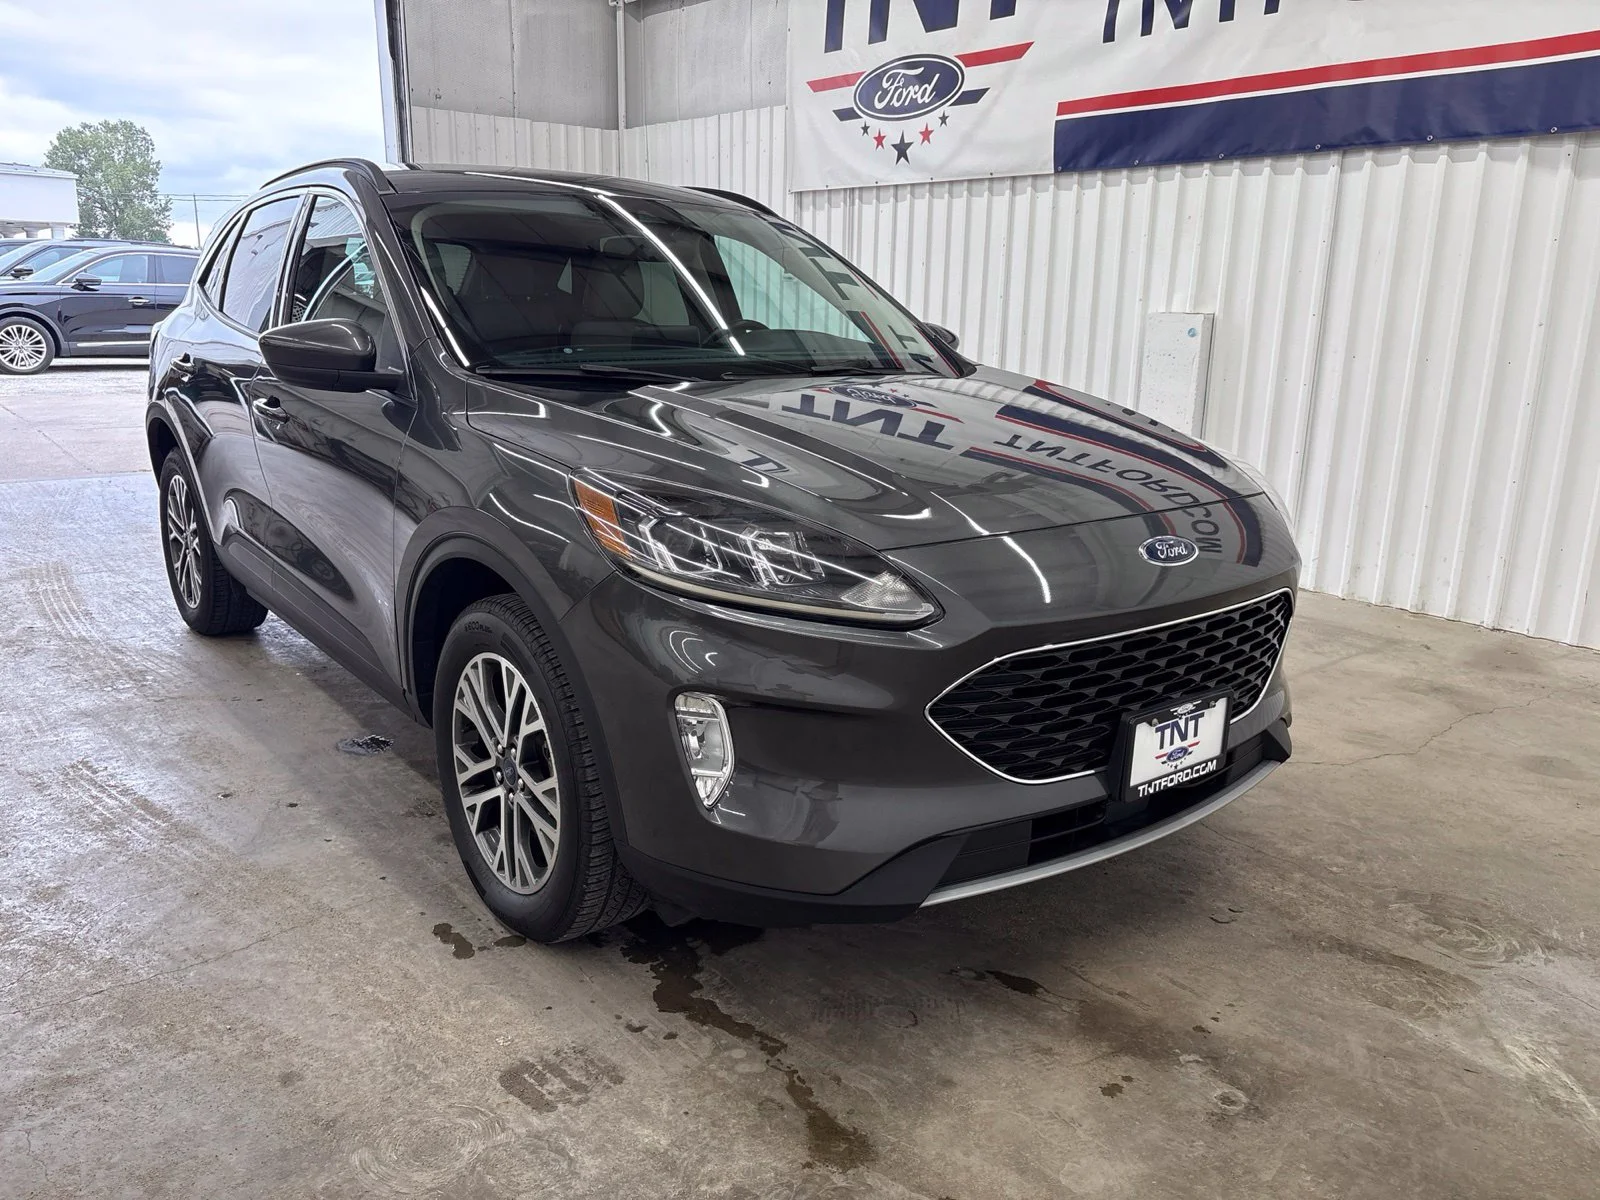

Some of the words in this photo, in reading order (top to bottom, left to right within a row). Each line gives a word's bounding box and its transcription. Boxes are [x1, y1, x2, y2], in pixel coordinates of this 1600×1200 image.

[874, 66, 941, 110] Ford
[1156, 540, 1188, 559] Ford
[1155, 712, 1204, 750] TNT
[1138, 760, 1217, 797] TNTFORD.COM
